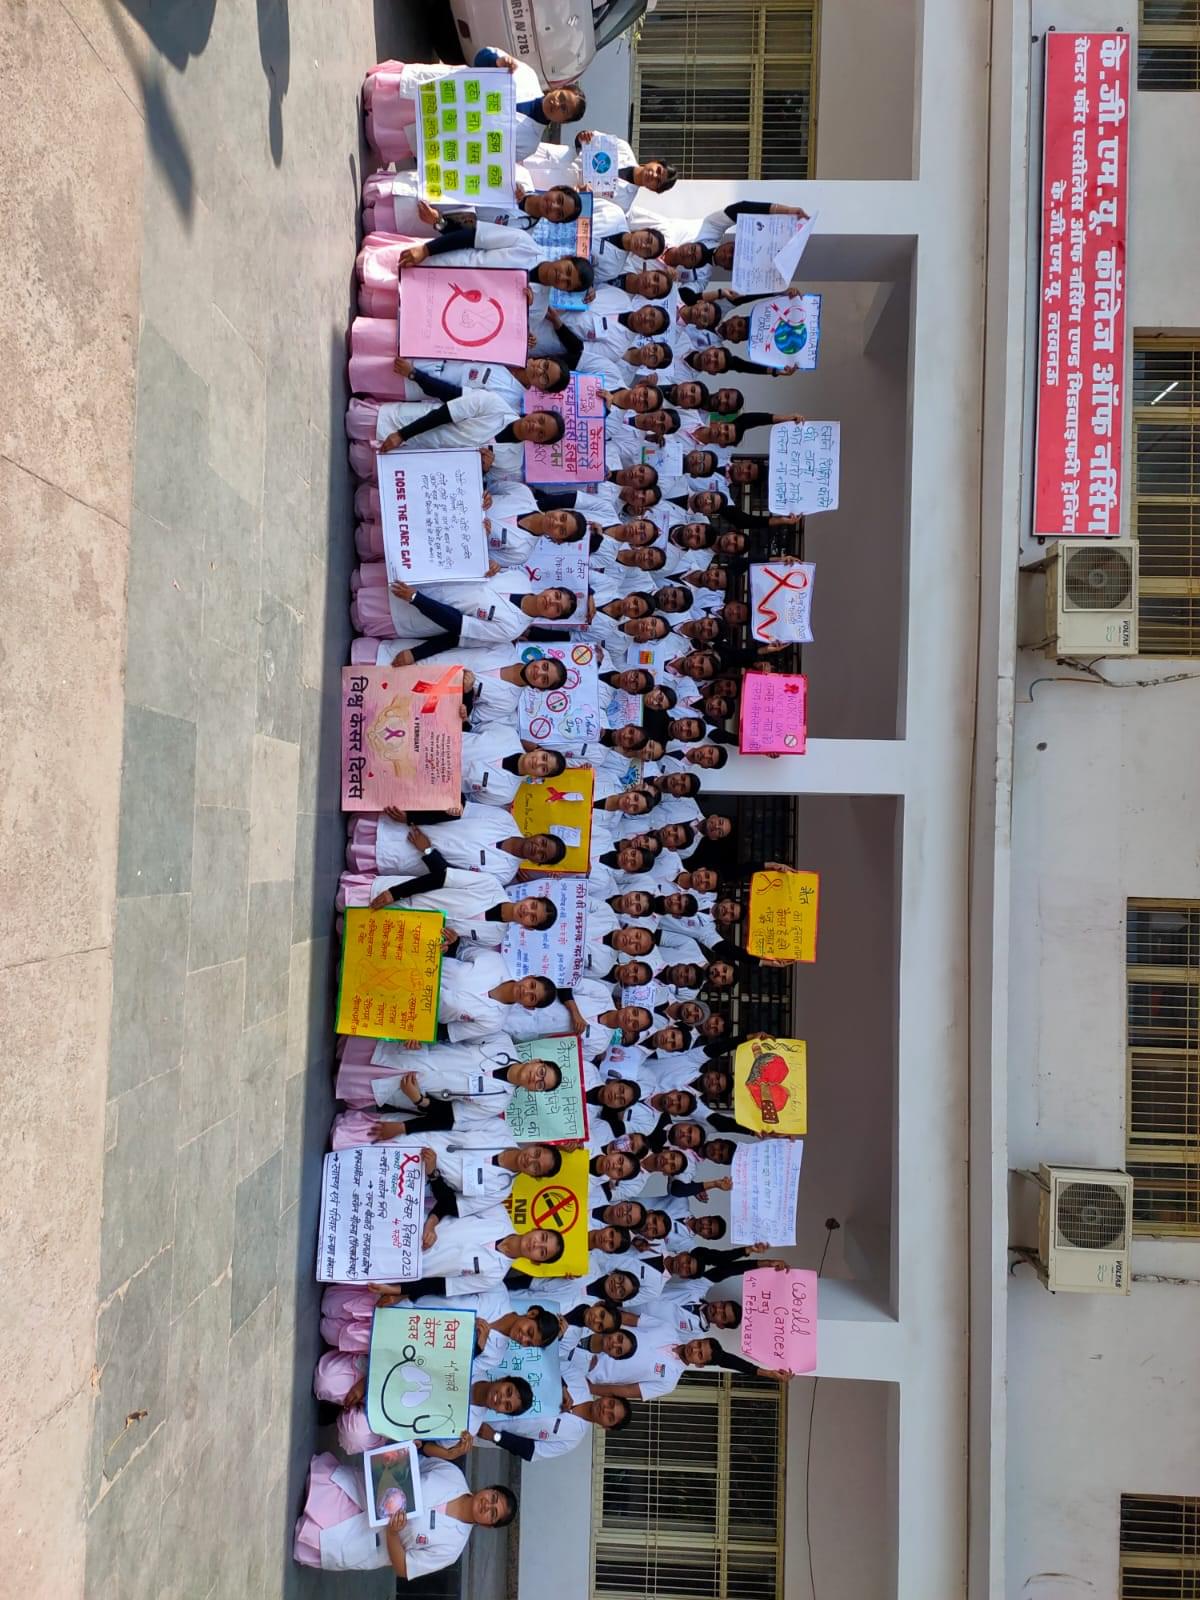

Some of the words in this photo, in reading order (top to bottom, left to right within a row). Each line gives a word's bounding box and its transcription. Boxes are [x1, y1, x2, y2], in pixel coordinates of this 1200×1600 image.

[513, 22, 527, 32] AV
[516, 34, 530, 55] 2783
[1074, 36, 1091, 84] सेन्टर
[1073, 87, 1090, 124] फॉर
[1070, 218, 1086, 262] ऑफ
[1068, 267, 1085, 321] नर्सिंग
[1093, 247, 1122, 353] कॉलेज
[1046, 311, 1061, 386] लखनऊ
[1066, 327, 1080, 368] एण्ड
[1091, 363, 1119, 437] ऑफ
[1063, 372, 1083, 477] मिडवाइफरी
[1061, 480, 1080, 533] ट्रेनिंग
[1088, 442, 1117, 533] नर्सिंग
[397, 504, 408, 522] THE
[399, 524, 410, 547] CARE
[401, 550, 412, 569] GAP
[420, 984, 434, 1014] कारण
[513, 1198, 527, 1225] NO
[402, 1250, 412, 1277] 2023
[758, 1290, 771, 1315] Day
[791, 1282, 810, 1336] World
[442, 1318, 460, 1351] विश्व
[742, 1295, 757, 1355] February
[773, 1306, 789, 1360] Cancer
